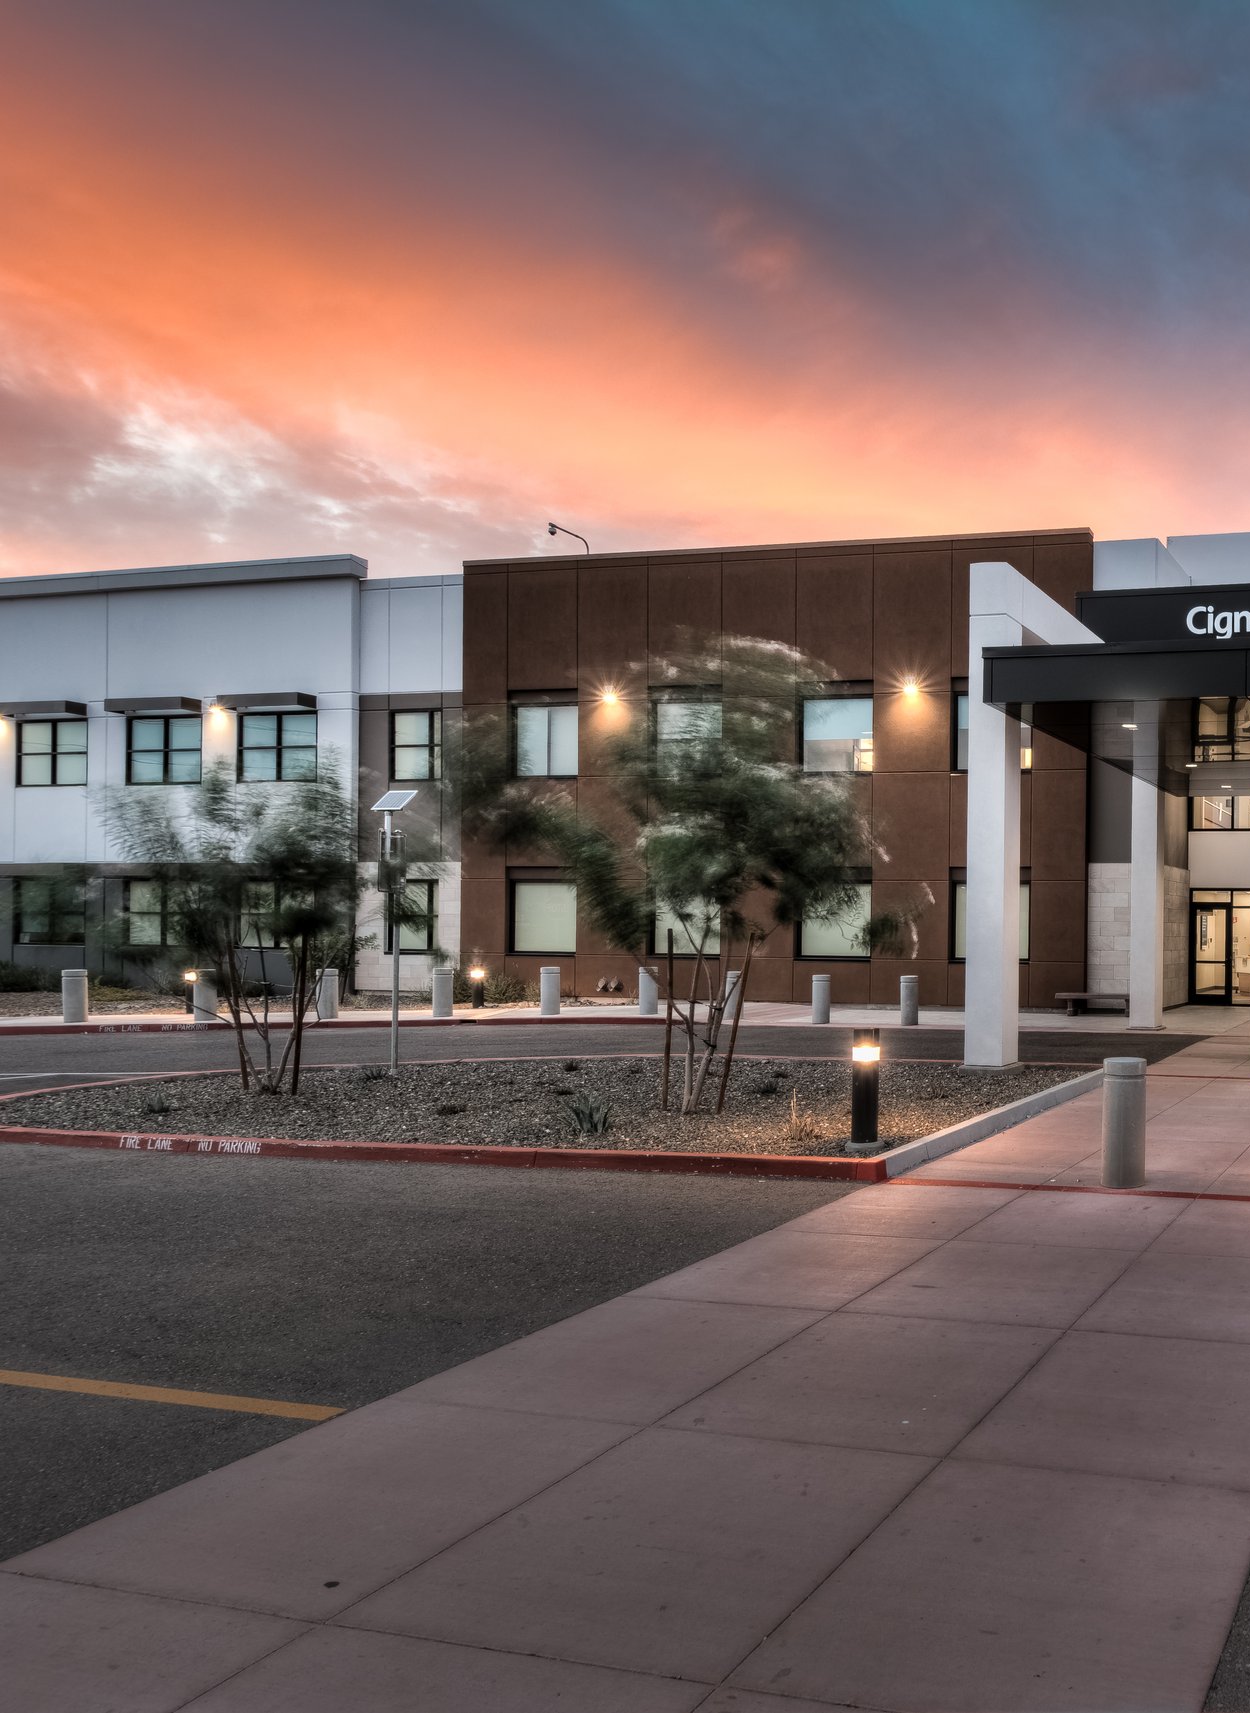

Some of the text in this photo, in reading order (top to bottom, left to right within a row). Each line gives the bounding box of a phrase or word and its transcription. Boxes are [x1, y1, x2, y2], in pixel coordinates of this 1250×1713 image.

[99, 1024, 116, 1032] FIRE
[121, 1024, 142, 1032] LANE
[177, 1023, 208, 1031] PARKING
[119, 1135, 261, 1154] FIRE LANE NO PARKING
